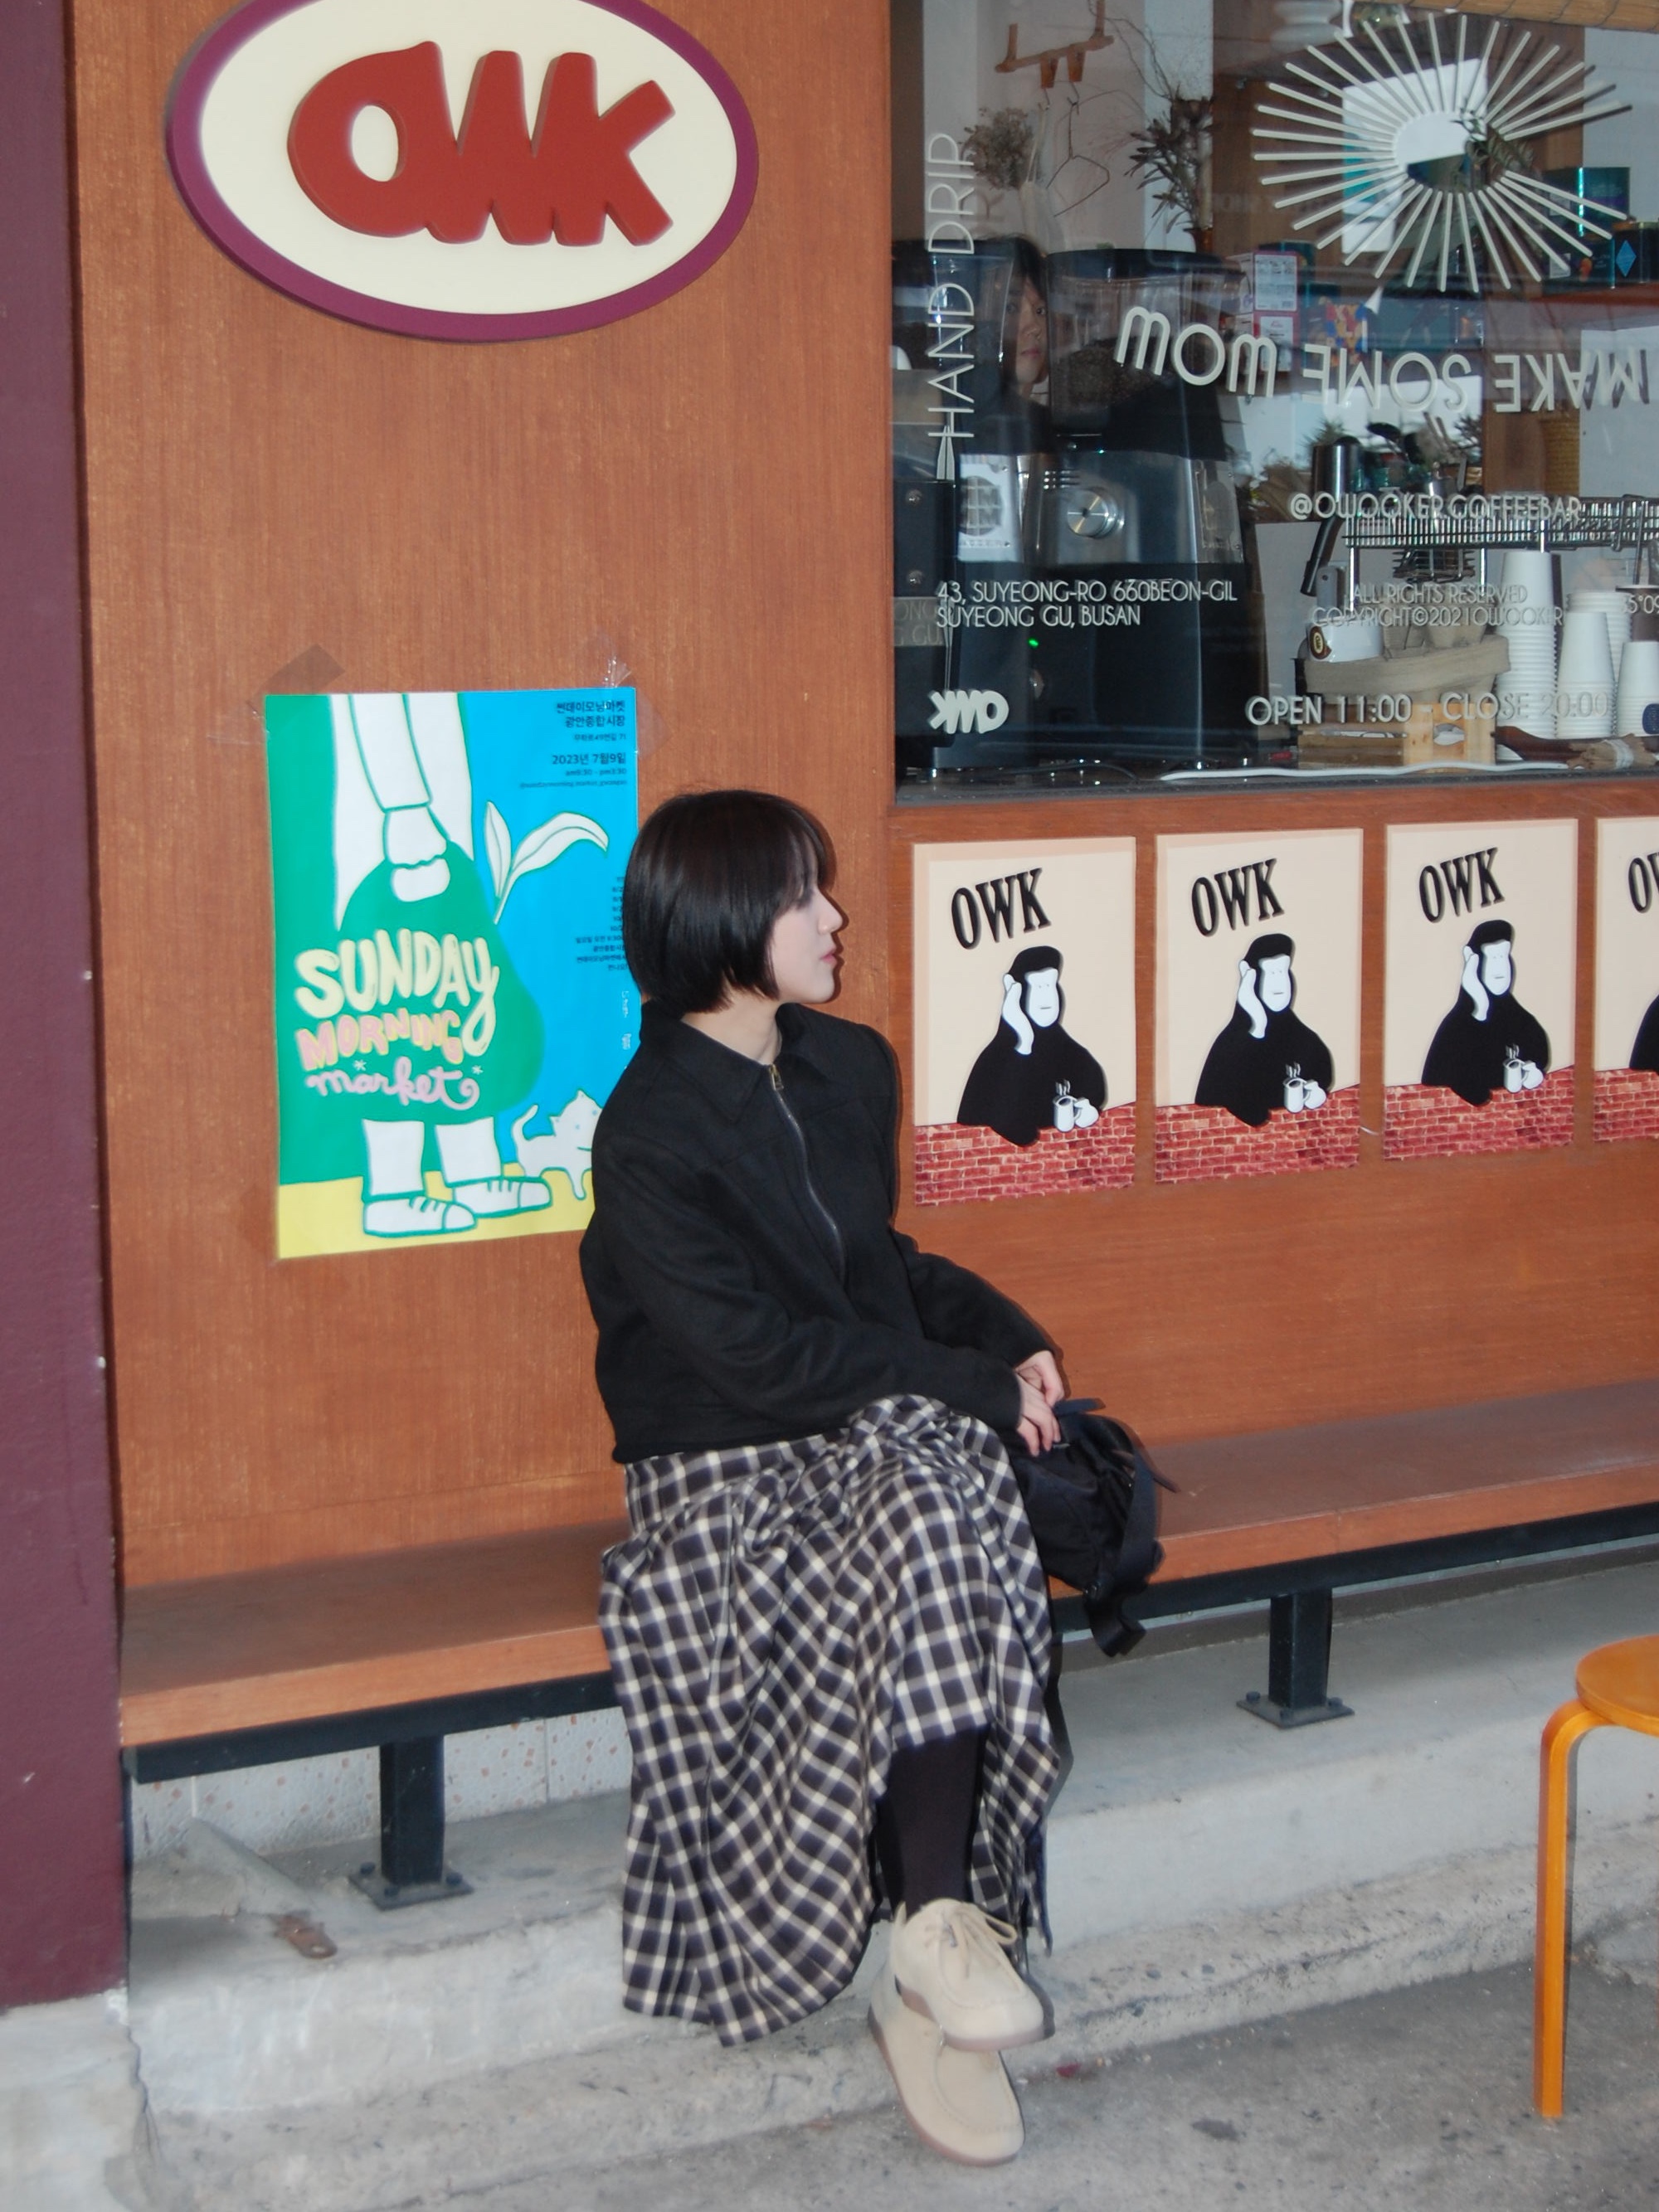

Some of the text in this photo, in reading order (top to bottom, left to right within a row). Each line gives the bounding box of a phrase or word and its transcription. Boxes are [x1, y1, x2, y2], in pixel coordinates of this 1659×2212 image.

[287, 40, 675, 246] OWK
[927, 133, 974, 437] HAND DRIP
[1302, 343, 1472, 413] SOME
[1495, 348, 1642, 413] MAKE
[937, 581, 966, 605] 43,
[972, 581, 1107, 603] SUYEONG-RO
[937, 605, 1035, 628] SUYEONG
[1043, 605, 1075, 629] GU,
[1081, 605, 1141, 626] BUSAN
[1354, 583, 1527, 604] ALL RIGHTS RESERVED
[1247, 696, 1322, 726] OPEN
[1335, 693, 1412, 723] 11:00
[1443, 691, 1530, 721] CLOSE
[1540, 691, 1608, 718] 20:00
[552, 753, 589, 766] 2023년
[951, 868, 1051, 950] OWK
[1191, 858, 1285, 937] OWK
[1419, 847, 1505, 923] OWK
[294, 927, 499, 1057] SUNDAY
[294, 1008, 465, 1072] MORNING
[305, 1056, 480, 1111] market
